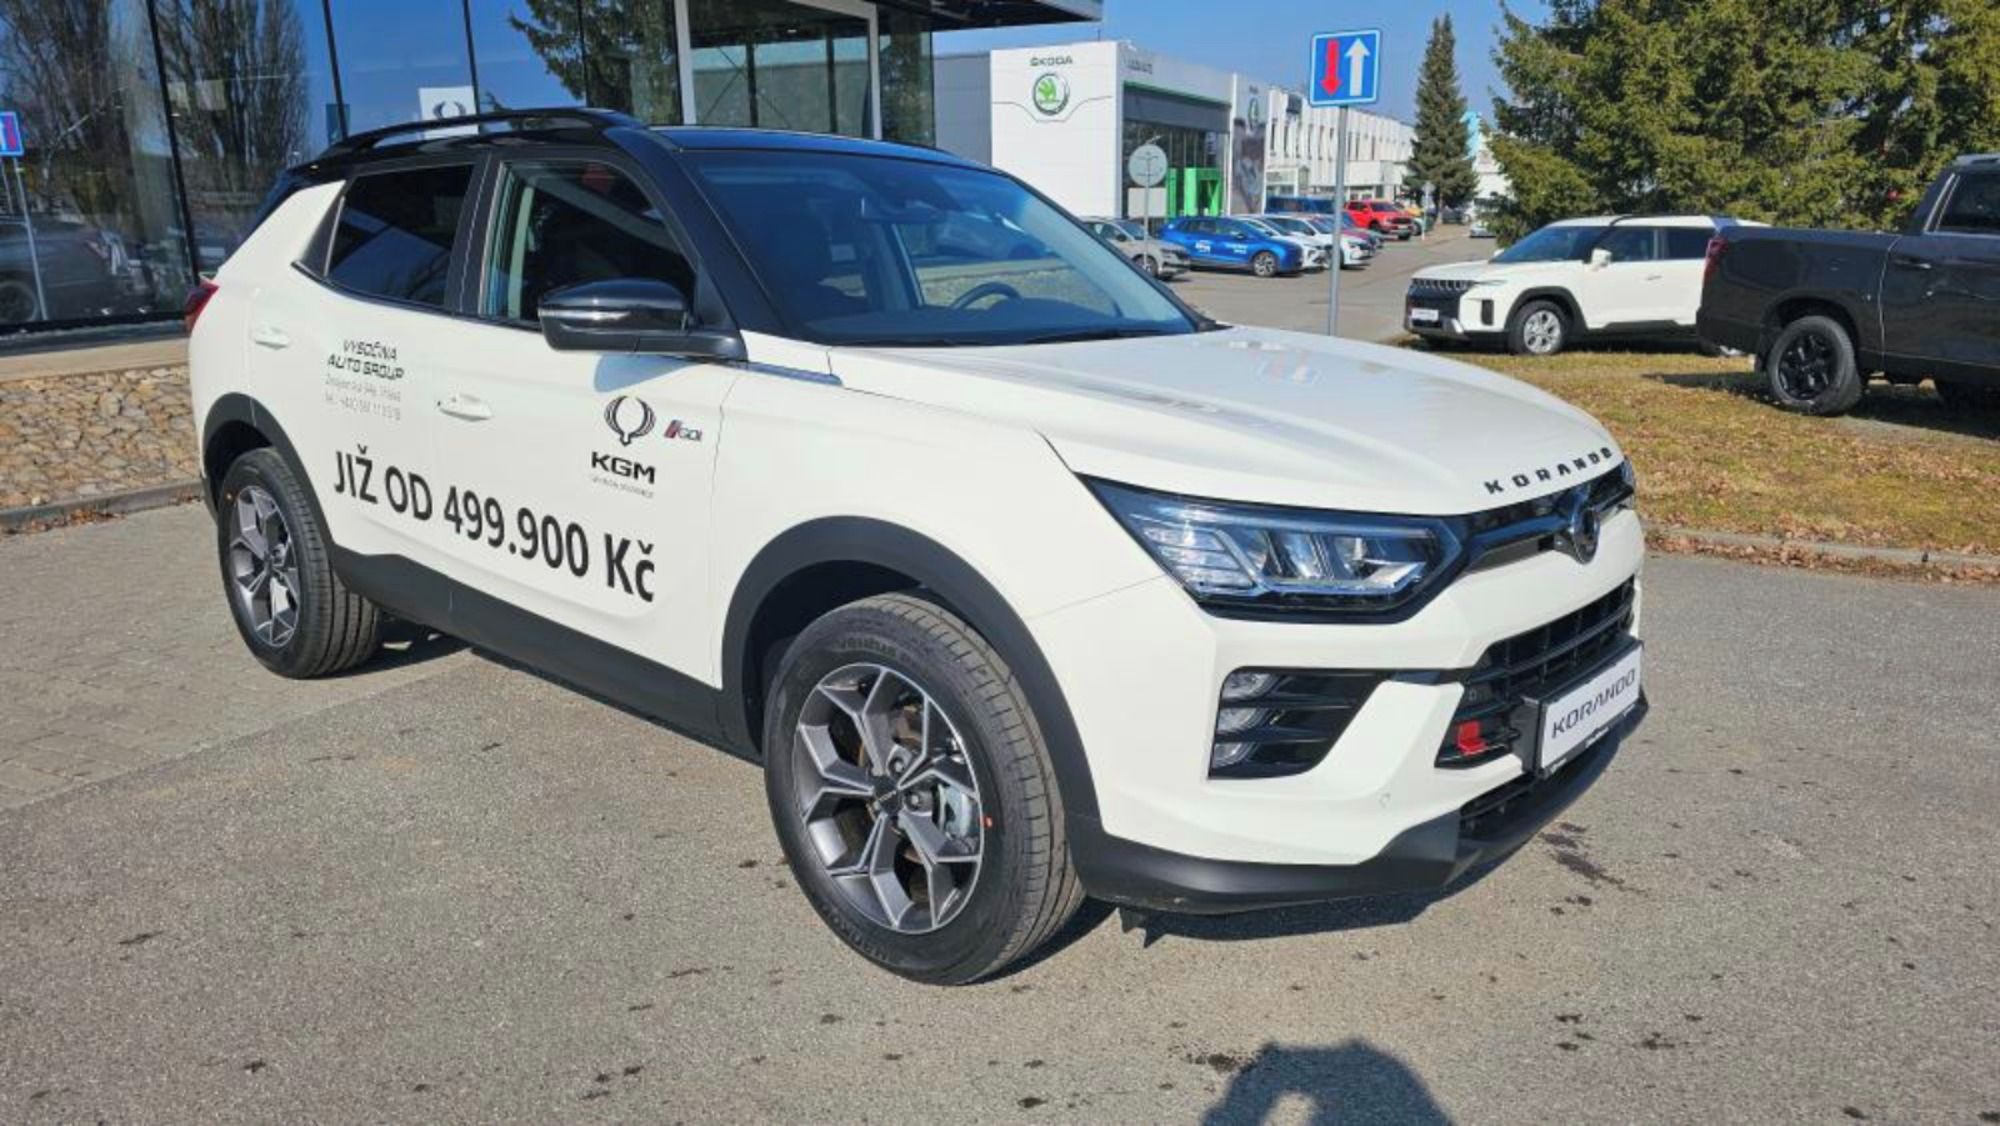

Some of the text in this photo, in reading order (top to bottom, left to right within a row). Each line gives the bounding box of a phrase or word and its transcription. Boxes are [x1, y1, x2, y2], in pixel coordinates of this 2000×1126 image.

[327, 353, 405, 381] AUTO GROUP
[591, 451, 656, 485] KGM
[1484, 447, 1612, 494] KORANDO
[335, 444, 655, 602] JIŽ OD 499.900 Kč
[1551, 668, 1636, 739] KORANDO
